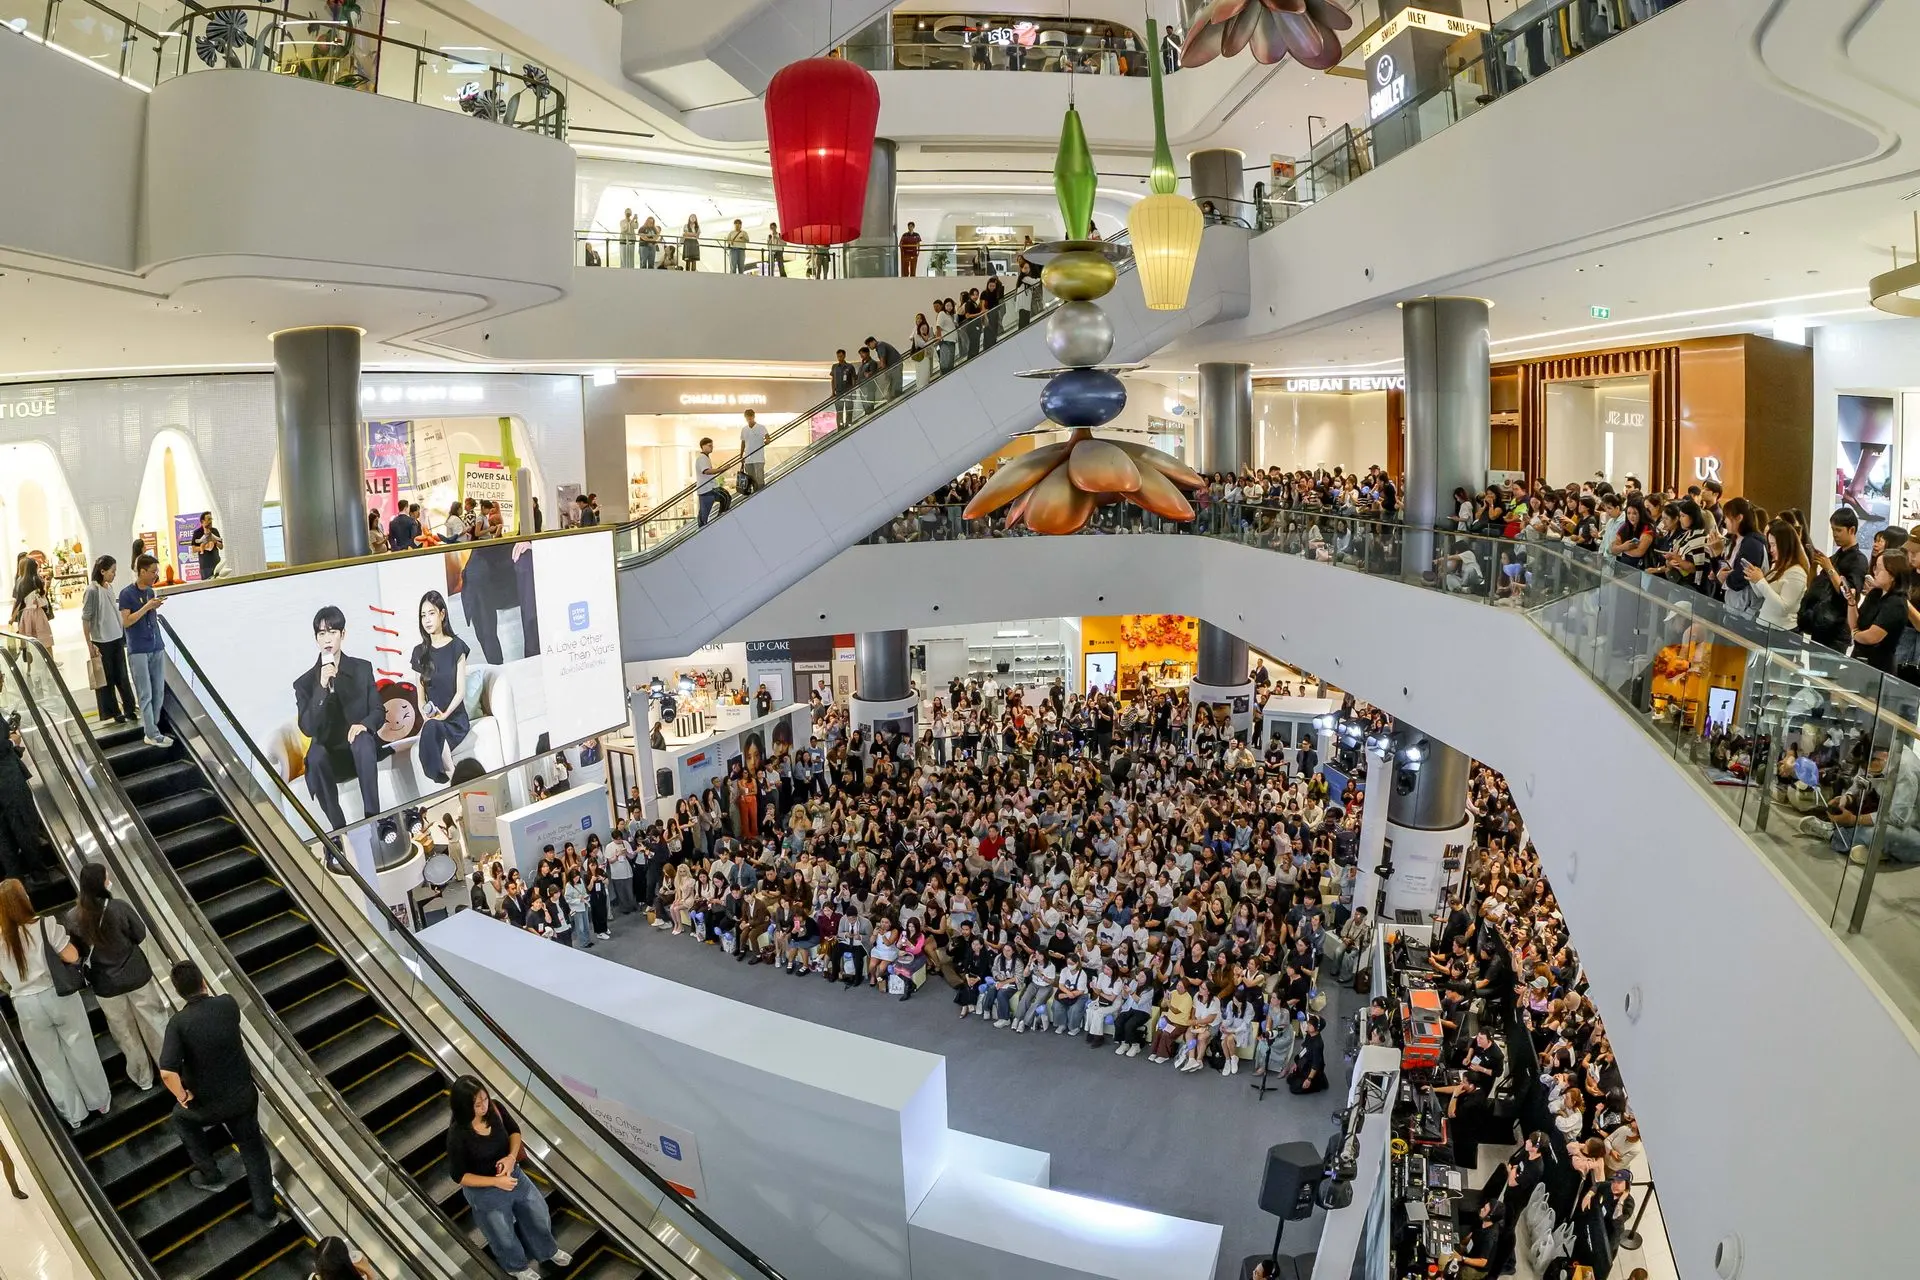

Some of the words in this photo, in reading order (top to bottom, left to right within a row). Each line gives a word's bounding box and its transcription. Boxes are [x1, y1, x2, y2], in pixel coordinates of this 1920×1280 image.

[1286, 378, 1343, 391] URBAN
[466, 471, 495, 481] POWER
[1694, 456, 1722, 483] UR
[466, 481, 500, 490] HANDLED
[466, 490, 485, 499] WITH
[486, 491, 505, 499] CARE
[546, 644, 554, 654] A
[556, 640, 578, 653] Love
[580, 633, 603, 647] Other
[746, 642, 765, 651] CUP
[766, 641, 790, 651] CAKE
[568, 650, 591, 662] Than
[592, 643, 615, 656] Yours
[589, 1104, 613, 1122] Love
[615, 1116, 643, 1135] Other
[631, 1133, 660, 1152] Yours
